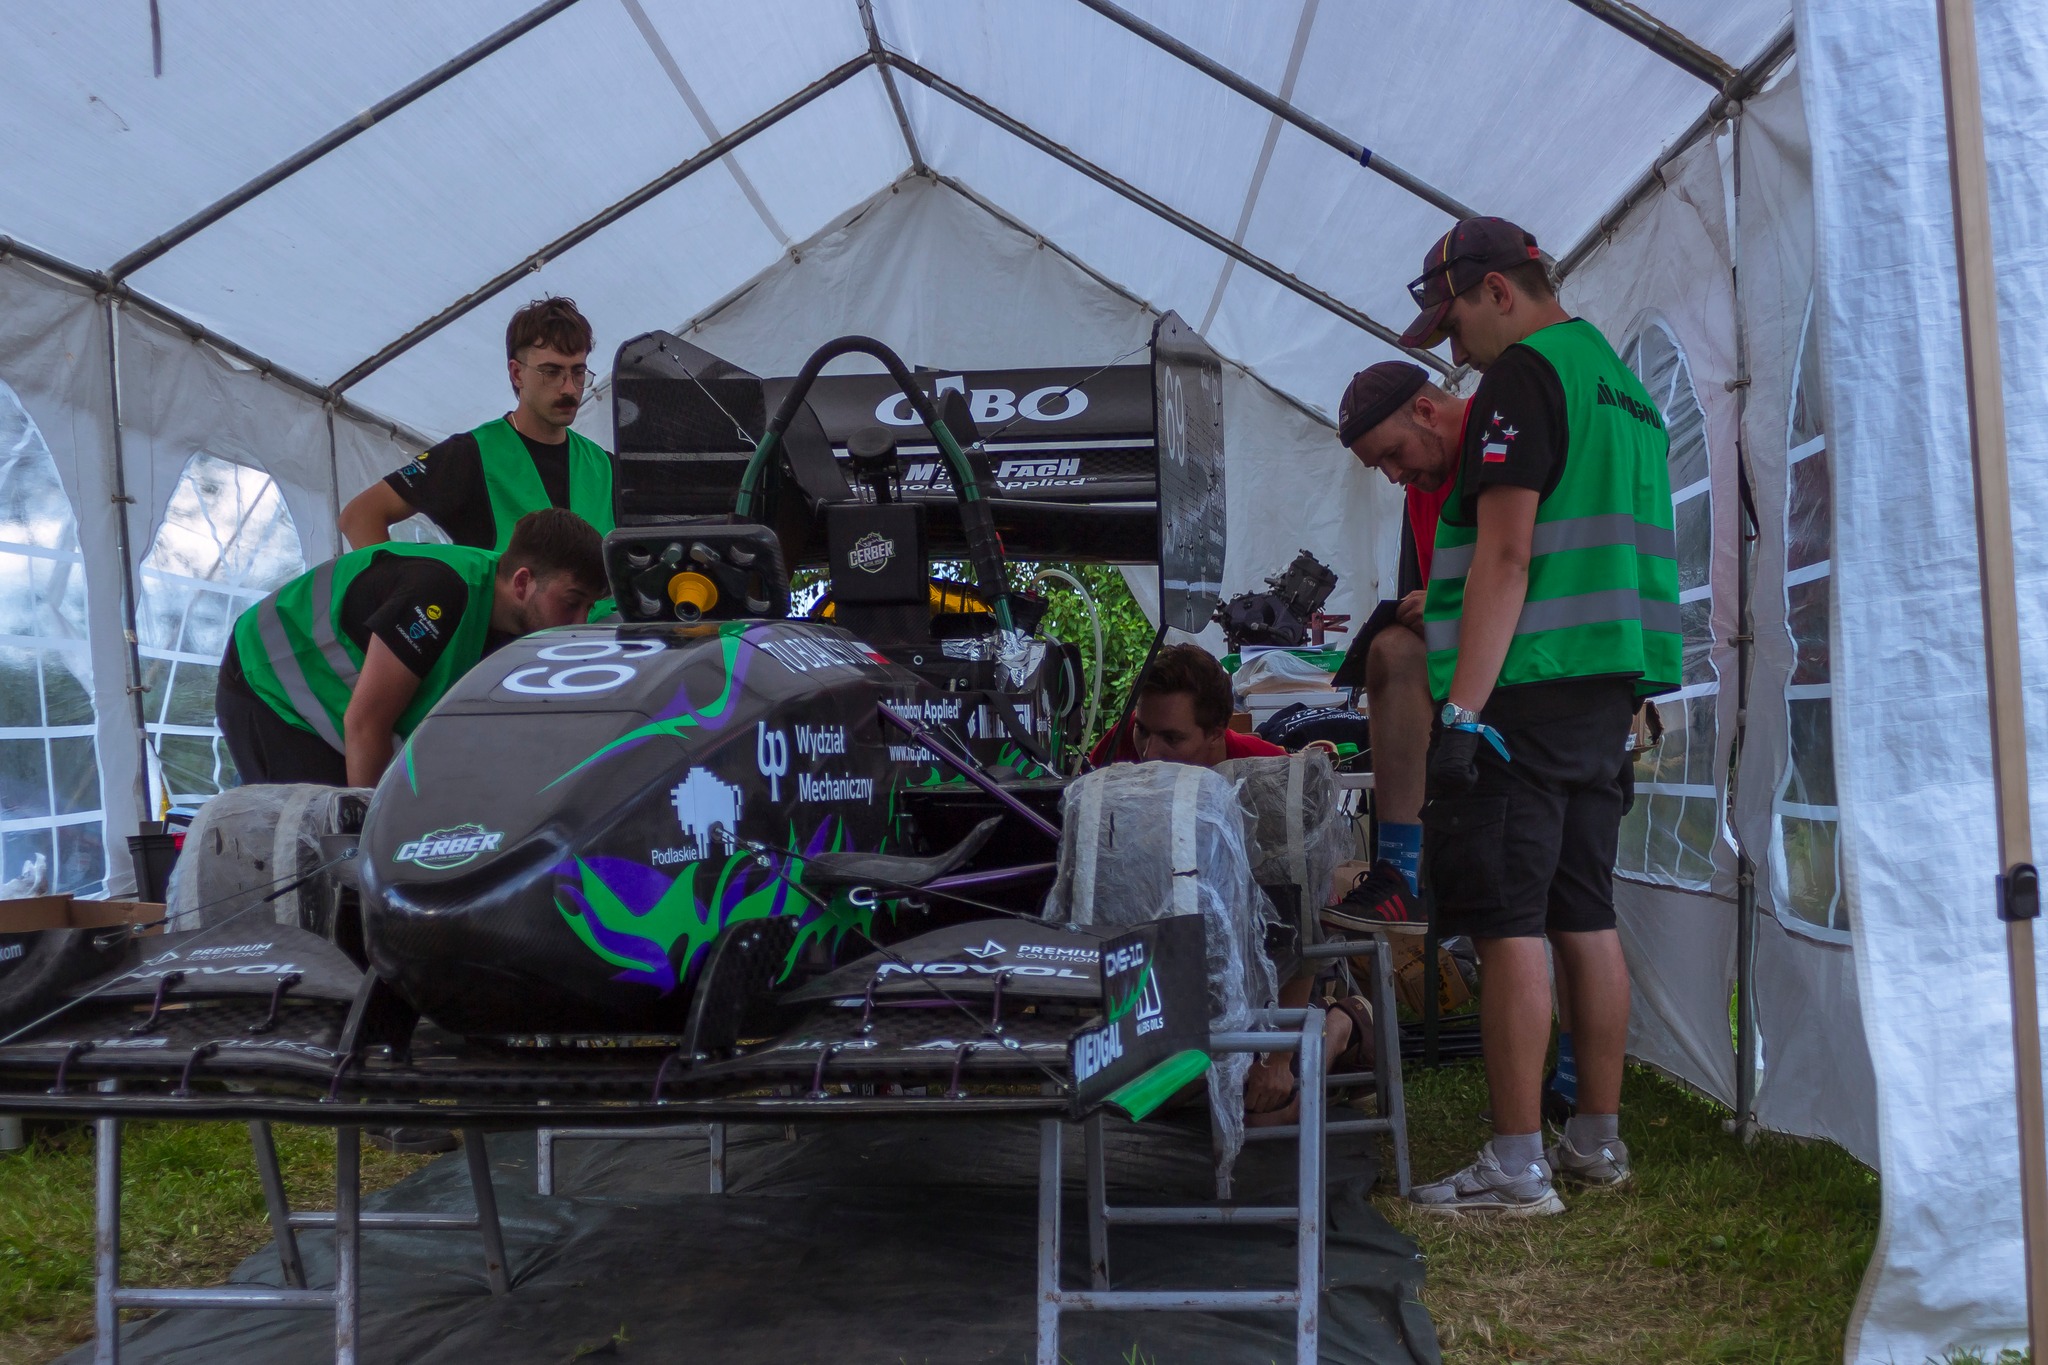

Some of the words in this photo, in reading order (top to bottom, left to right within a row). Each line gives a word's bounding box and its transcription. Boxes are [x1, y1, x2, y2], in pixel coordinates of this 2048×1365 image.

[1164, 364, 1185, 468] 69
[849, 540, 894, 567] CERBER
[501, 640, 667, 694] 69
[795, 724, 846, 762] Wydział
[798, 771, 873, 806] Mechaniczny
[395, 833, 502, 861] CERBER
[651, 845, 698, 866] Podlaskie
[185, 950, 265, 961] SOLUTIONS
[189, 942, 273, 957] PREMIUM
[1015, 952, 1100, 964] SOLUTION
[876, 963, 1090, 979] NOVOL
[1073, 1021, 1124, 1082] MEDGAL
